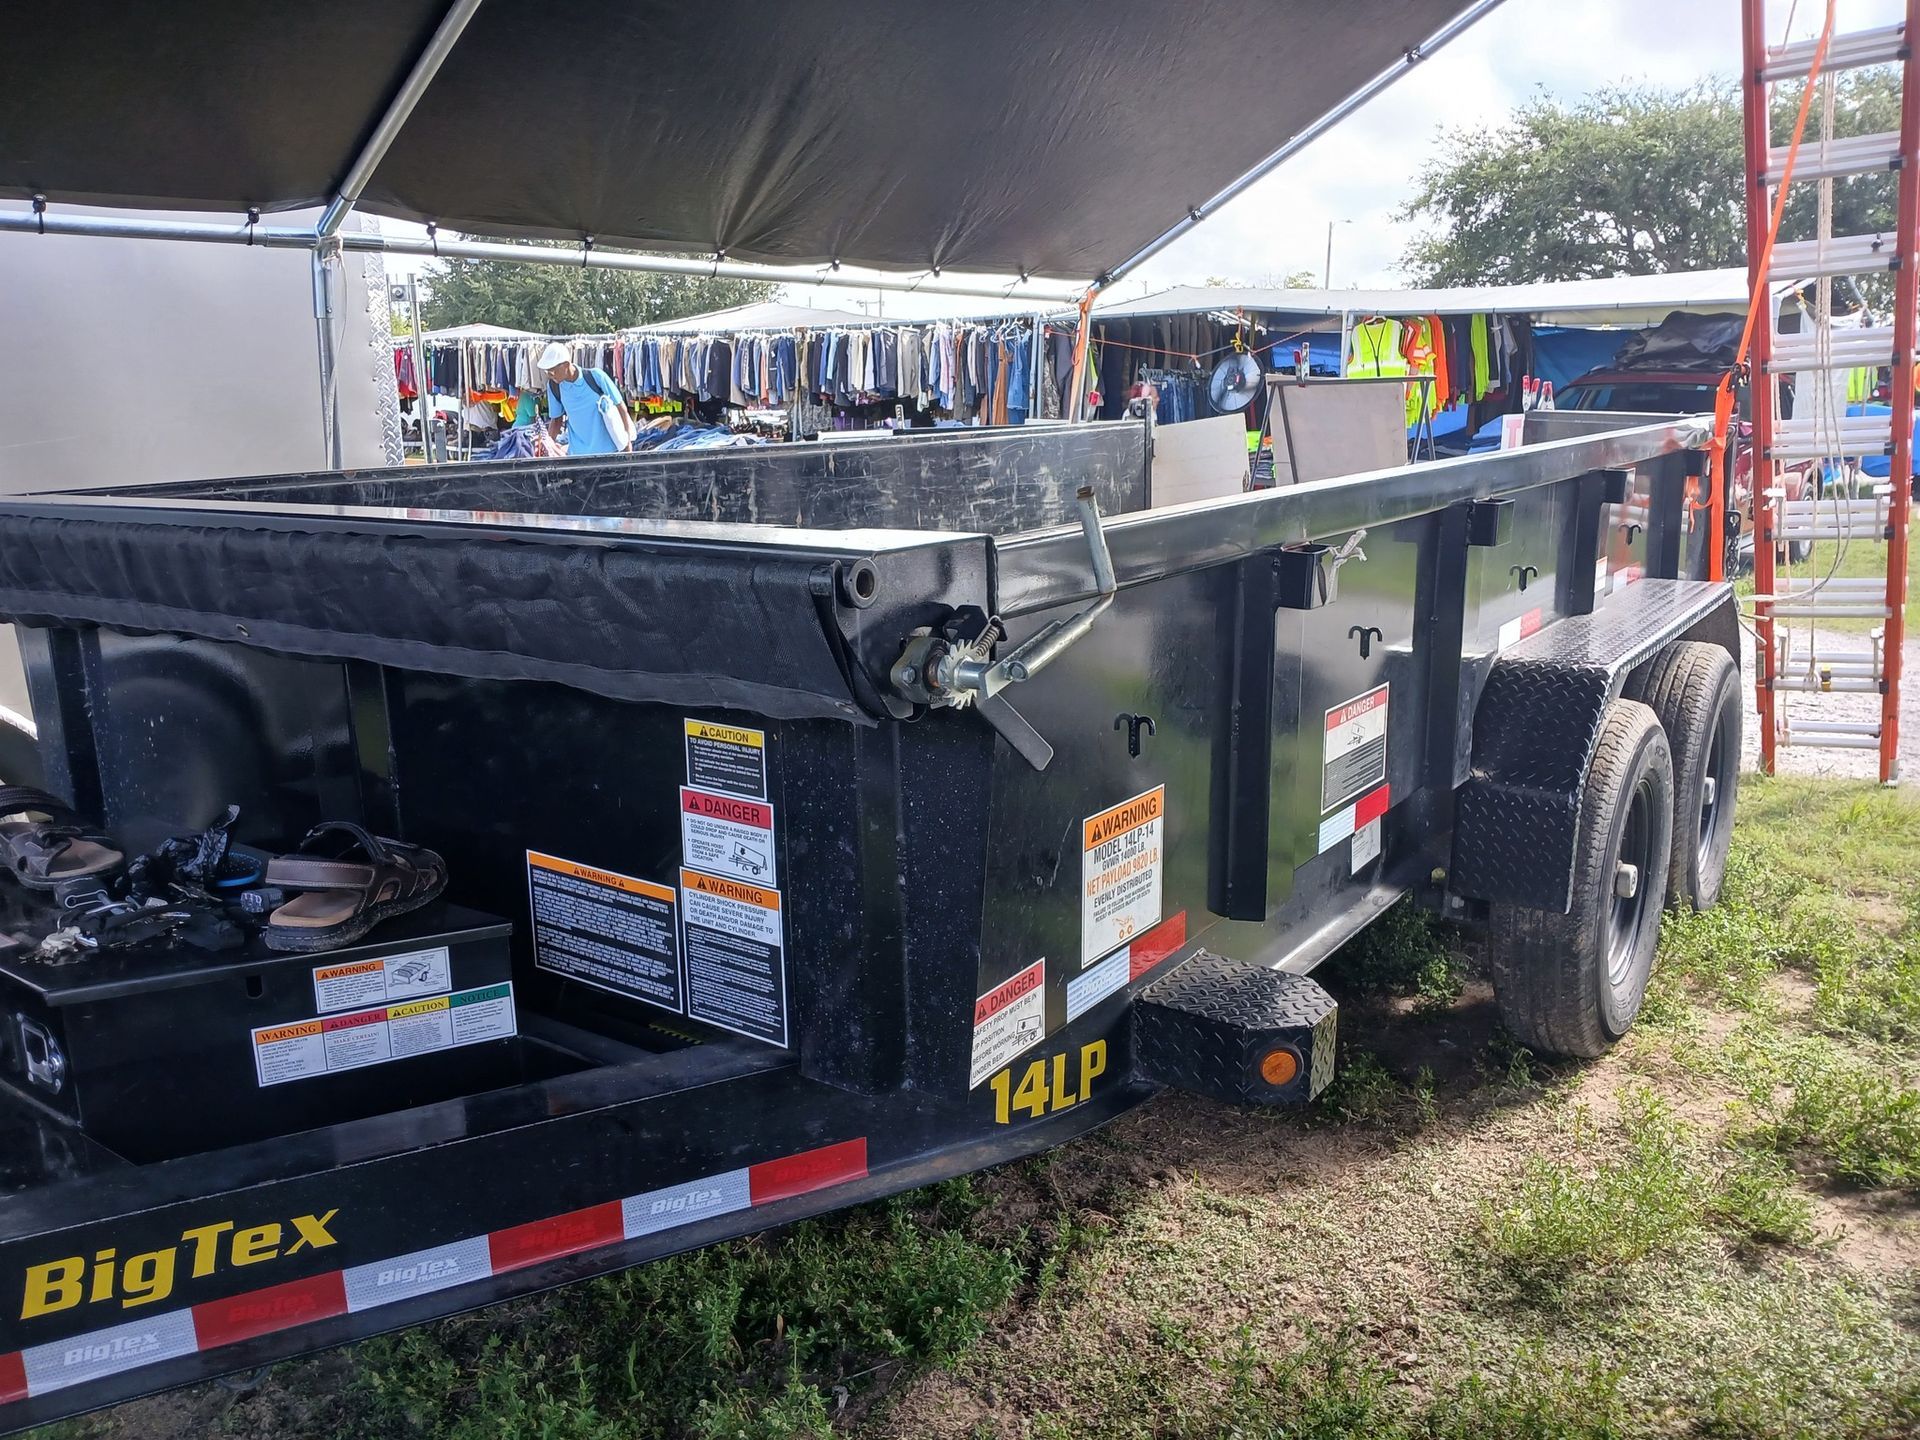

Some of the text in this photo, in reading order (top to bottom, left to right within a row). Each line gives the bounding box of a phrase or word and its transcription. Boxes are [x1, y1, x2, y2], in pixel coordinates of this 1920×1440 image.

[1348, 696, 1375, 719] DANGER
[698, 738, 713, 747] AVOID
[713, 741, 741, 752] PERSONAL
[709, 727, 749, 743] CAUTION
[704, 798, 760, 823] DANGER
[1103, 796, 1157, 837] WARNING
[714, 823, 728, 831] UNDER
[727, 831, 742, 839] CAUSE
[1094, 821, 1154, 864] MODEL 14LP-14
[1102, 854, 1120, 871] GVWR
[1121, 845, 1137, 861] 14000
[580, 869, 617, 886] WARNING
[1087, 876, 1100, 897] NET
[1102, 861, 1132, 889] PAYLOAD
[1132, 852, 1149, 872] 9820
[709, 879, 763, 905] WARNING
[1094, 868, 1153, 908] EVENLY DISTRIBUTED
[688, 891, 768, 917] CYLINDER SHOCK PRESSURE
[689, 899, 765, 924] CAN CAUSE SEVERE INJURY
[690, 914, 700, 922] THE
[701, 918, 714, 926] UNIT
[715, 921, 727, 930] AND
[698, 909, 716, 919] DEATH
[717, 915, 739, 926] AND/OR
[740, 920, 764, 932] DAMAGE
[765, 926, 774, 935] TO
[330, 963, 376, 977] WARNING
[460, 988, 499, 1003] NOTICE
[990, 971, 1036, 1012] DANGER
[341, 1013, 382, 1027] DANGER
[401, 1000, 445, 1016] CAUTION
[993, 1010, 1009, 1026] PROP
[1009, 1000, 1024, 1015] MUST
[1023, 995, 1031, 1006] BE
[261, 1023, 317, 1041] WARNING
[980, 1026, 1005, 1049] POSITION
[972, 1031, 1016, 1066] BEFORE WORKING
[972, 1063, 992, 1079] UNDER
[990, 1038, 1107, 1125] 14LP
[651, 1187, 722, 1215] BigTex
[20, 1208, 339, 1321] BigTex
[376, 1257, 458, 1286] BigTex
[63, 1332, 158, 1366] BigTex
